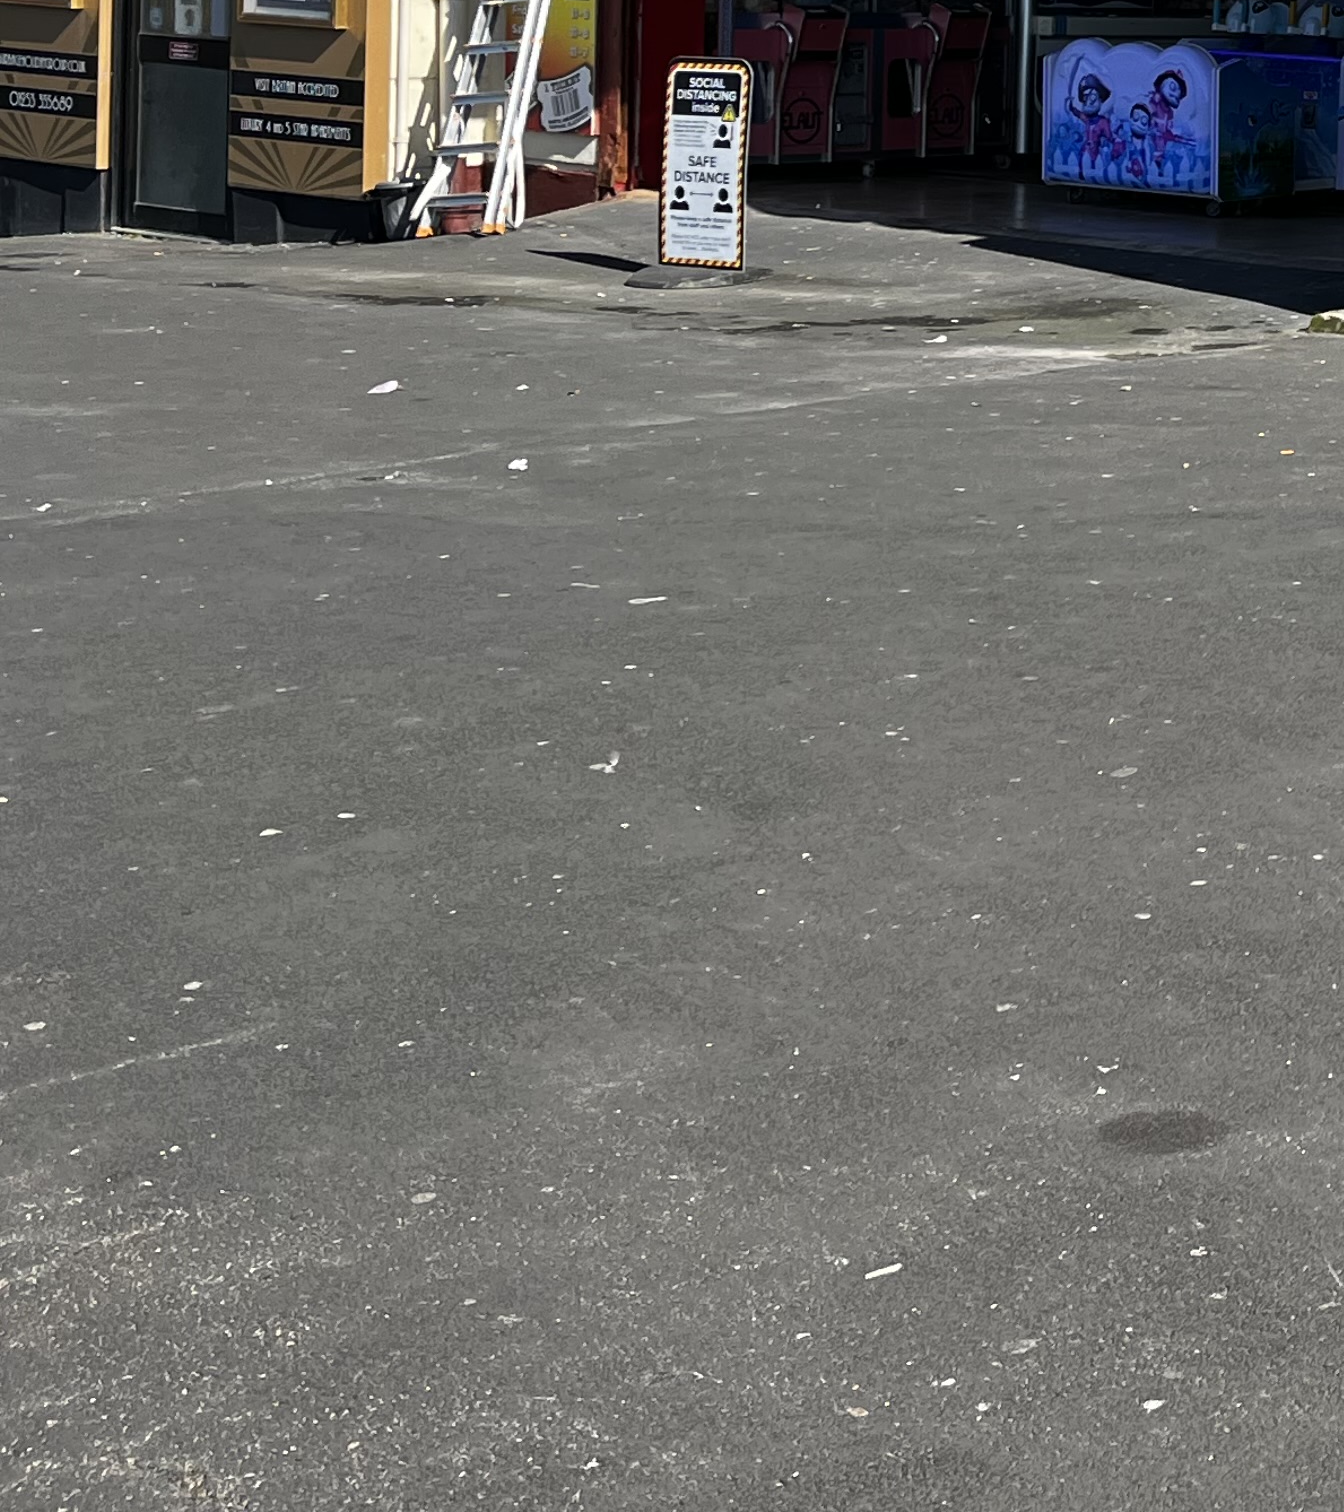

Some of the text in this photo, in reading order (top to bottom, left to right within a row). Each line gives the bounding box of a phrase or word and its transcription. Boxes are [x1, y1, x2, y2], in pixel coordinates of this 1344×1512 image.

[689, 76, 726, 89] SOCIAL
[676, 88, 738, 102] DISTANCING
[691, 101, 720, 114] inside
[265, 120, 272, 133] 4
[284, 121, 292, 135] 5
[688, 155, 718, 168] SAFE
[673, 170, 730, 185] DISTANCE
